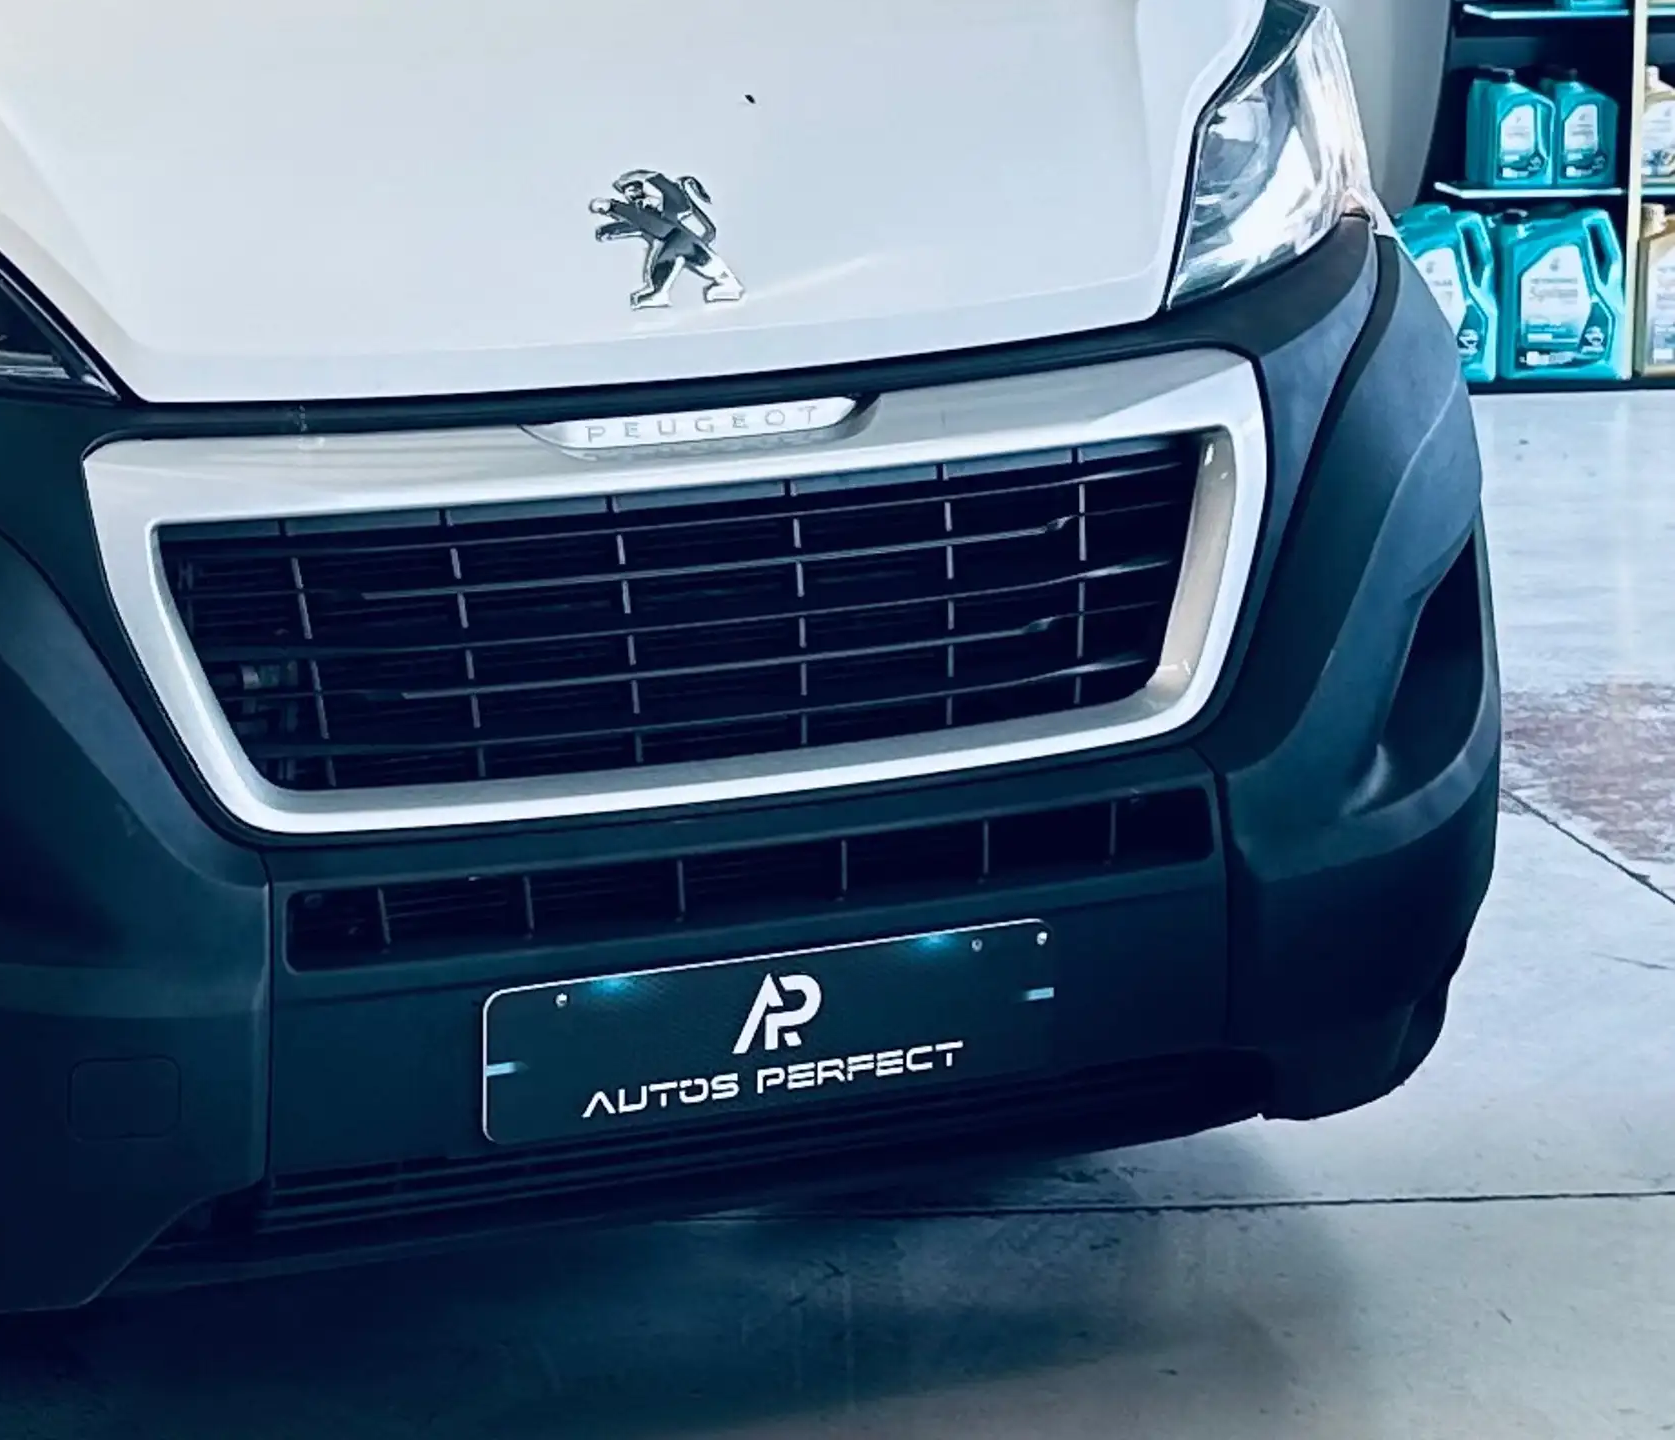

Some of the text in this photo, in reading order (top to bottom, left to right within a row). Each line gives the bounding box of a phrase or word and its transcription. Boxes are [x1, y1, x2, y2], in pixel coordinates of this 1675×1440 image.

[584, 405, 818, 444] PEUGEOT
[581, 1040, 965, 1118] AUTOS PERFECT
